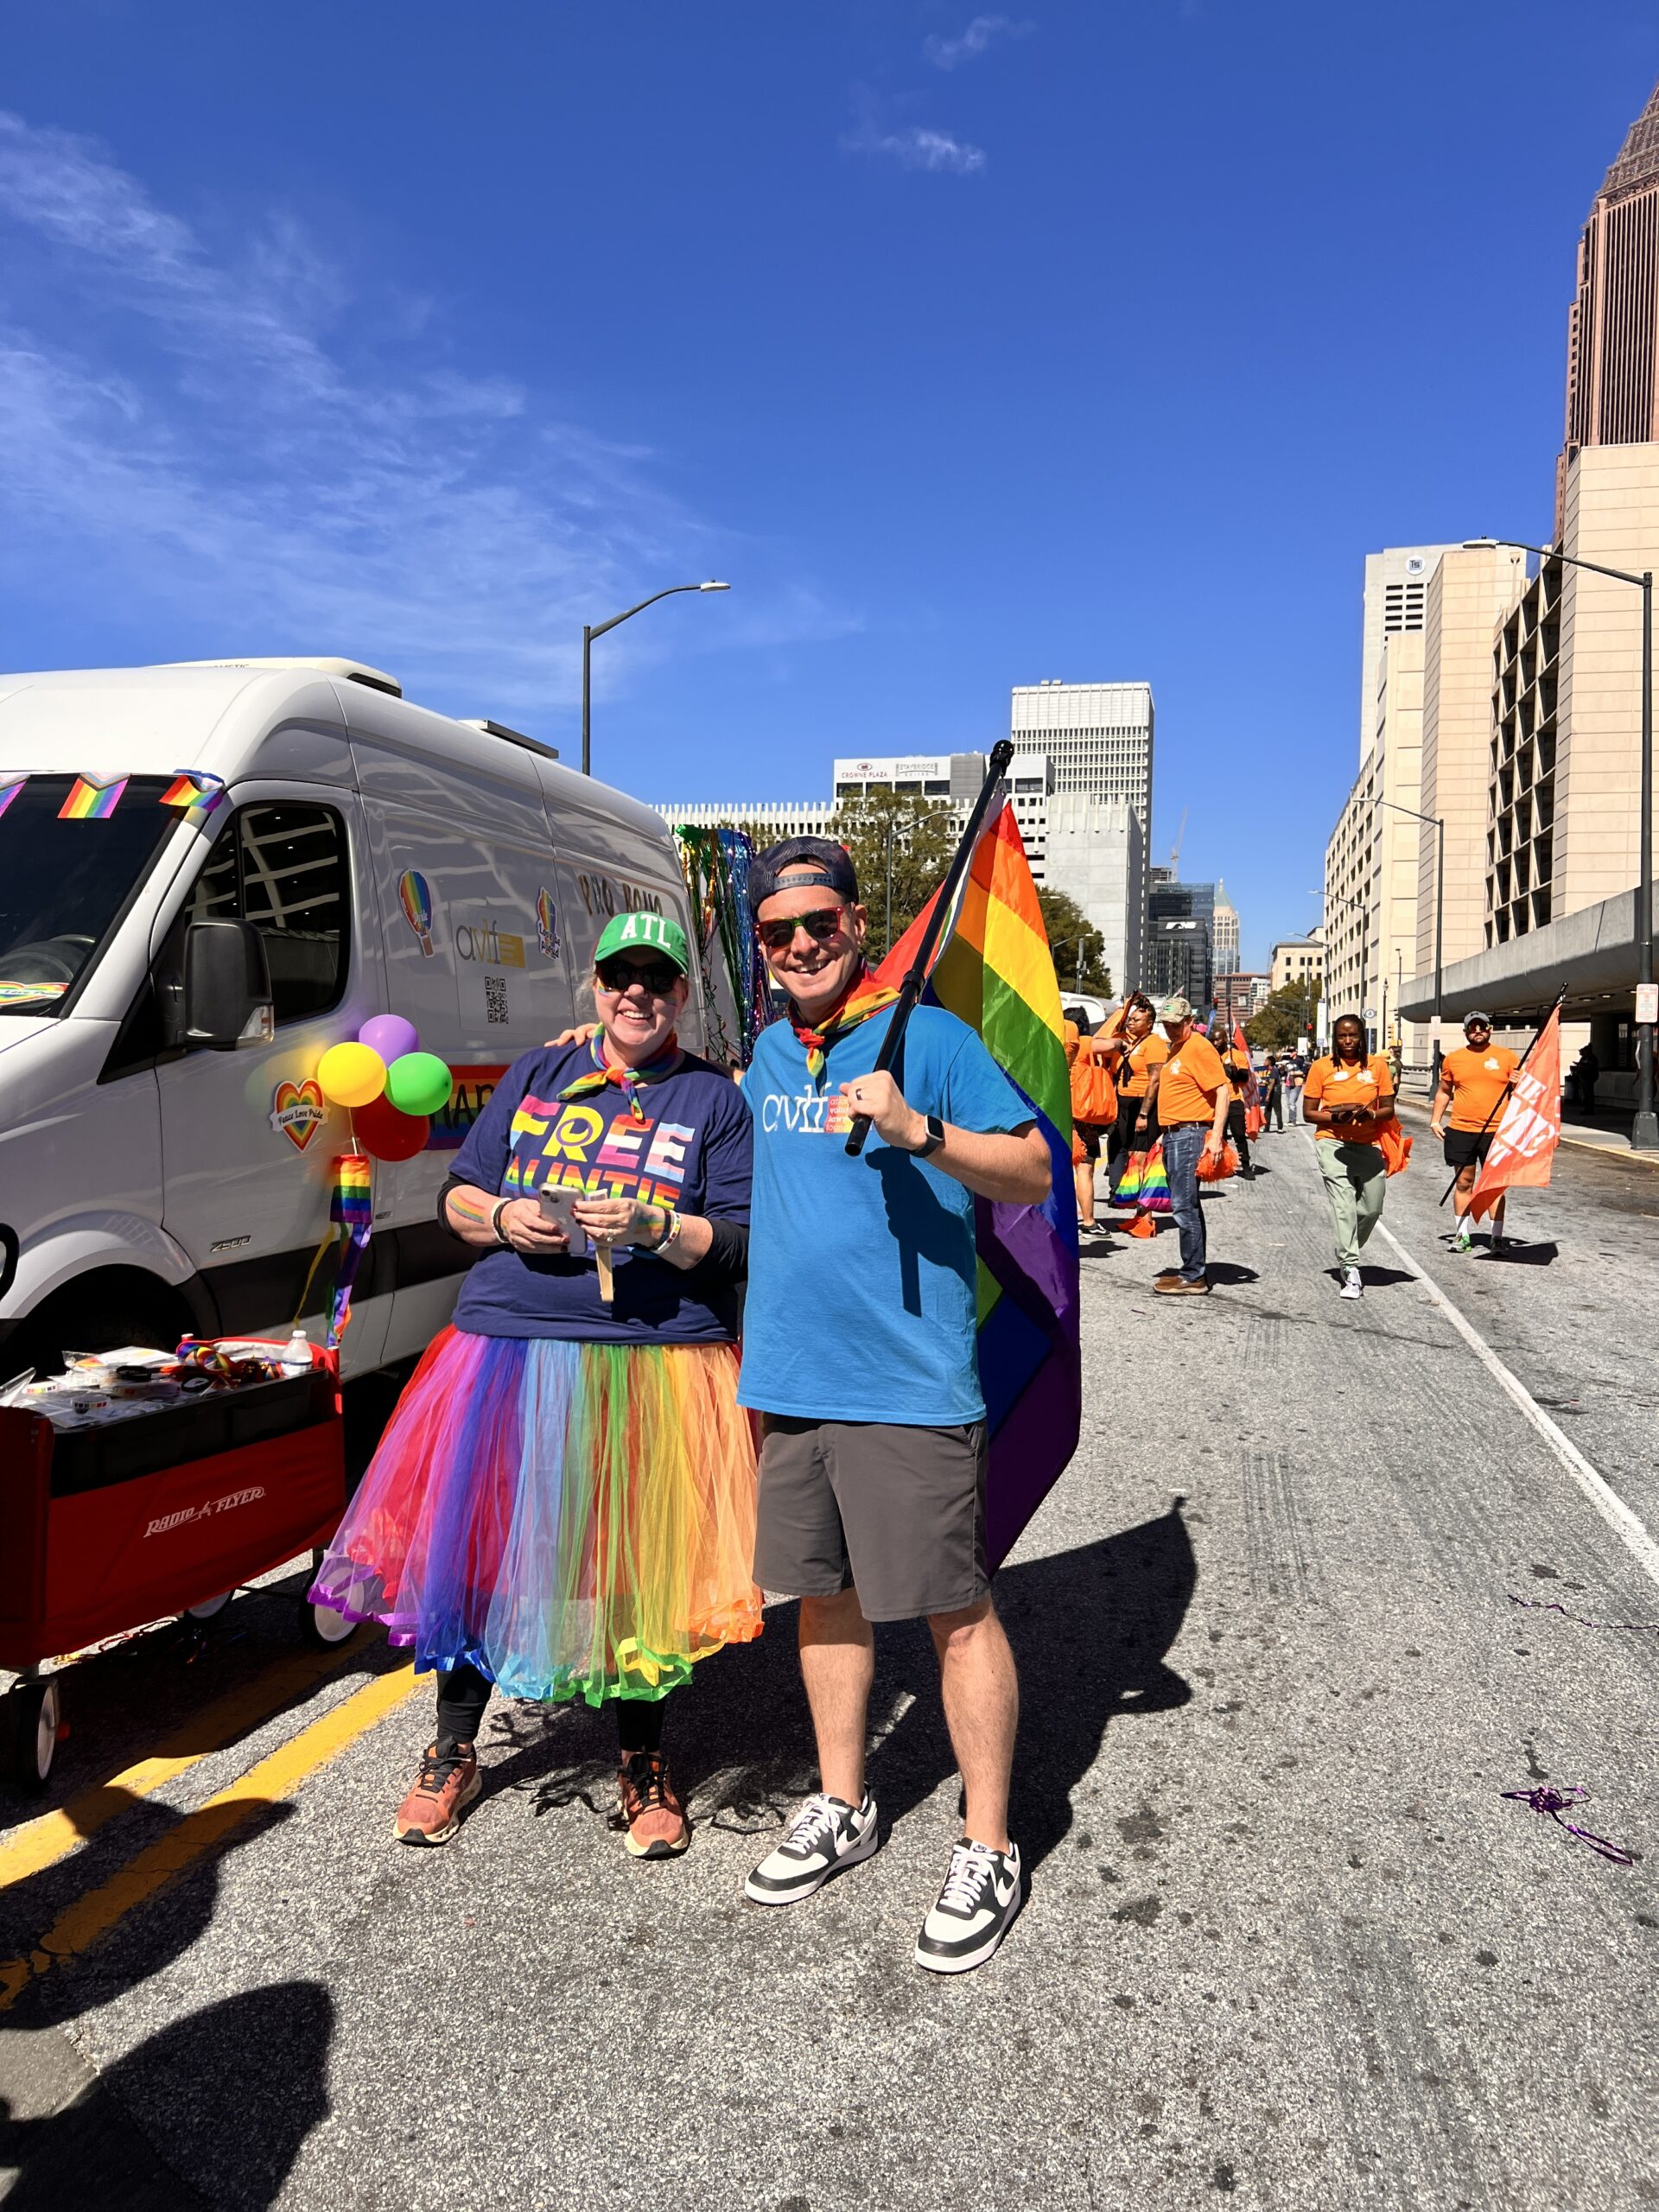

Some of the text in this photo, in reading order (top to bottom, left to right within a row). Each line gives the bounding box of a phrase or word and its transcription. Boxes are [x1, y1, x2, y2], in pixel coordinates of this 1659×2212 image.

[620, 913, 671, 949] ATL
[278, 1108, 323, 1125] Peace Love Pride
[510, 1094, 696, 1184] FREE
[210, 1235, 251, 1253] 2500
[143, 1486, 264, 1539] RADIO FLYER
